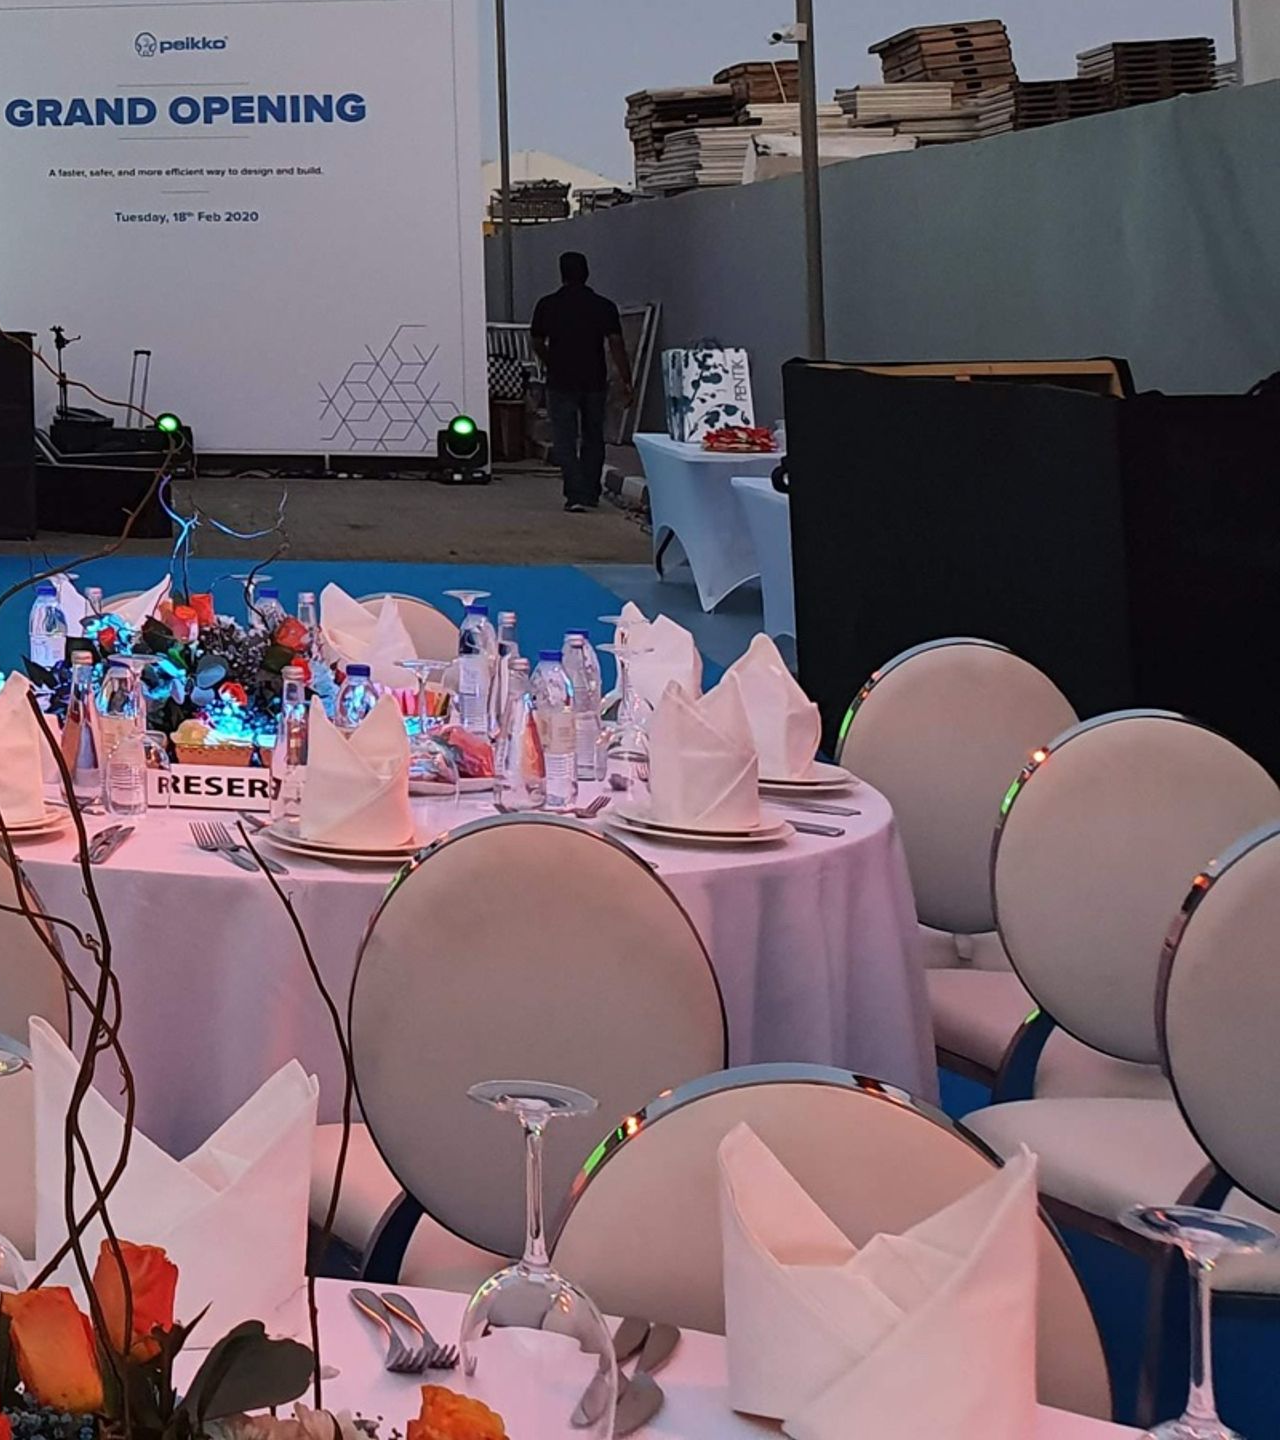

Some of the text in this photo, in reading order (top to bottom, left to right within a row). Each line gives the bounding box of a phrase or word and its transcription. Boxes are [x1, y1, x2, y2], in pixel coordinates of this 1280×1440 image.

[5, 93, 366, 127] GRAND OPENING
[48, 169, 56, 177] A
[58, 168, 88, 178] faster,
[89, 168, 115, 177] safer,
[117, 168, 136, 176] and
[165, 167, 204, 176] efficient
[206, 168, 226, 177] way
[228, 167, 239, 176] to
[240, 167, 274, 177] design
[275, 166, 295, 175] and
[115, 212, 169, 224] Tuesday,
[197, 211, 222, 222] Feb
[224, 211, 260, 222] 2020
[731, 359, 748, 402] PENTIK
